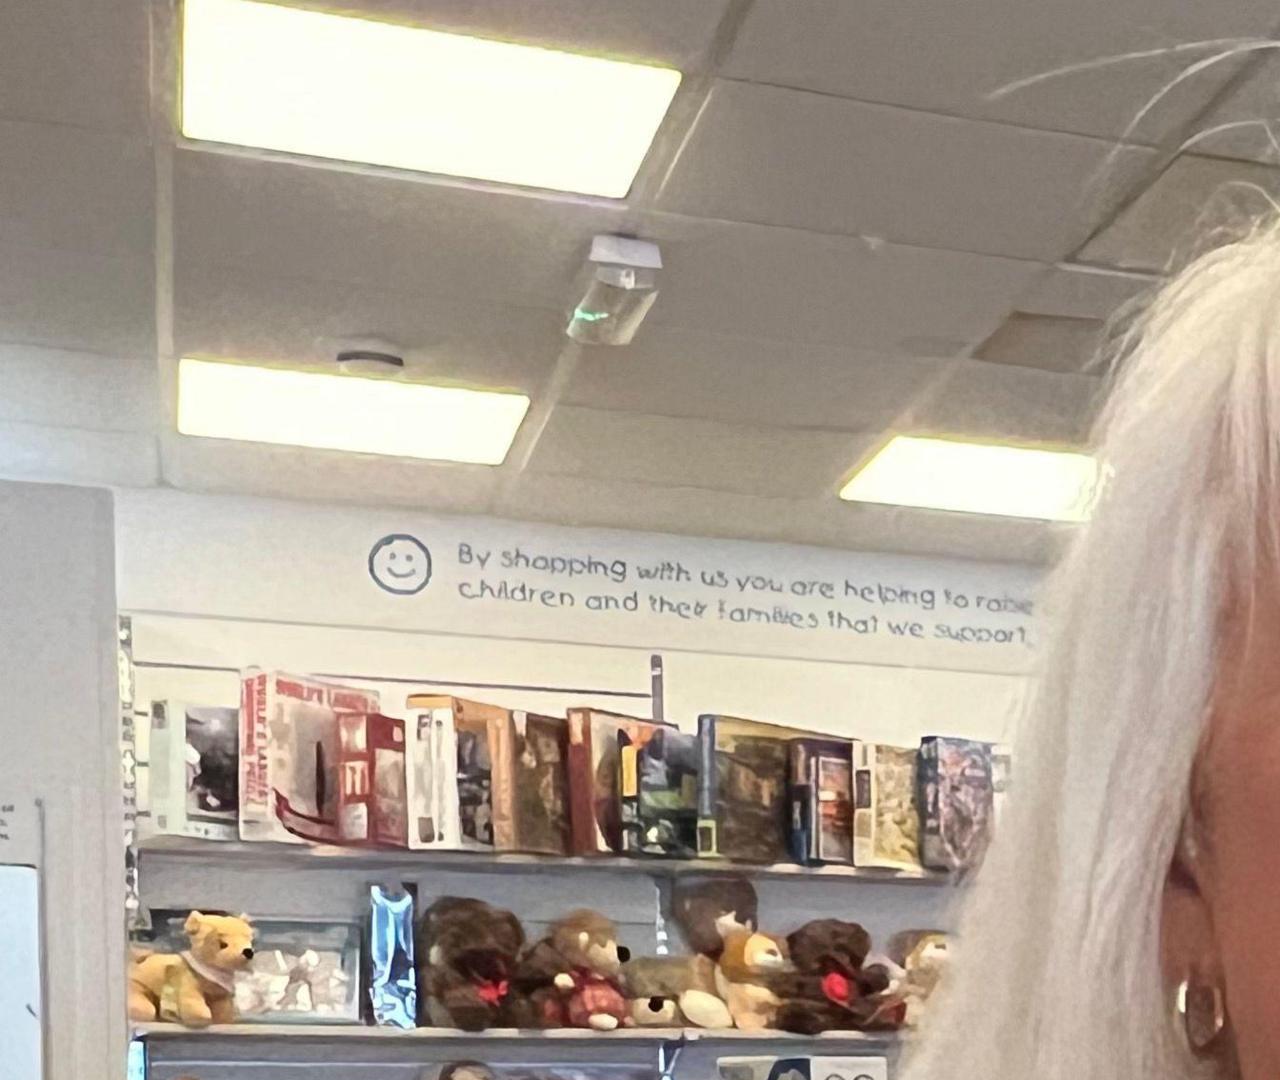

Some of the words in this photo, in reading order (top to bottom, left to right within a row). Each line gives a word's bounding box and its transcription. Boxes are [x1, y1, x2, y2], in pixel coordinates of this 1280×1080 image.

[458, 542, 491, 569] By
[501, 548, 627, 583] shopping
[636, 561, 692, 582] with
[701, 570, 729, 588] us
[736, 574, 783, 593] you
[790, 578, 835, 599] are
[844, 579, 936, 610] helping
[944, 588, 970, 609] to
[458, 579, 575, 608] children
[585, 591, 639, 612] and
[649, 594, 708, 619] their
[718, 600, 819, 629] families
[828, 611, 878, 634] that
[887, 620, 924, 638] we
[934, 622, 1027, 644] support
